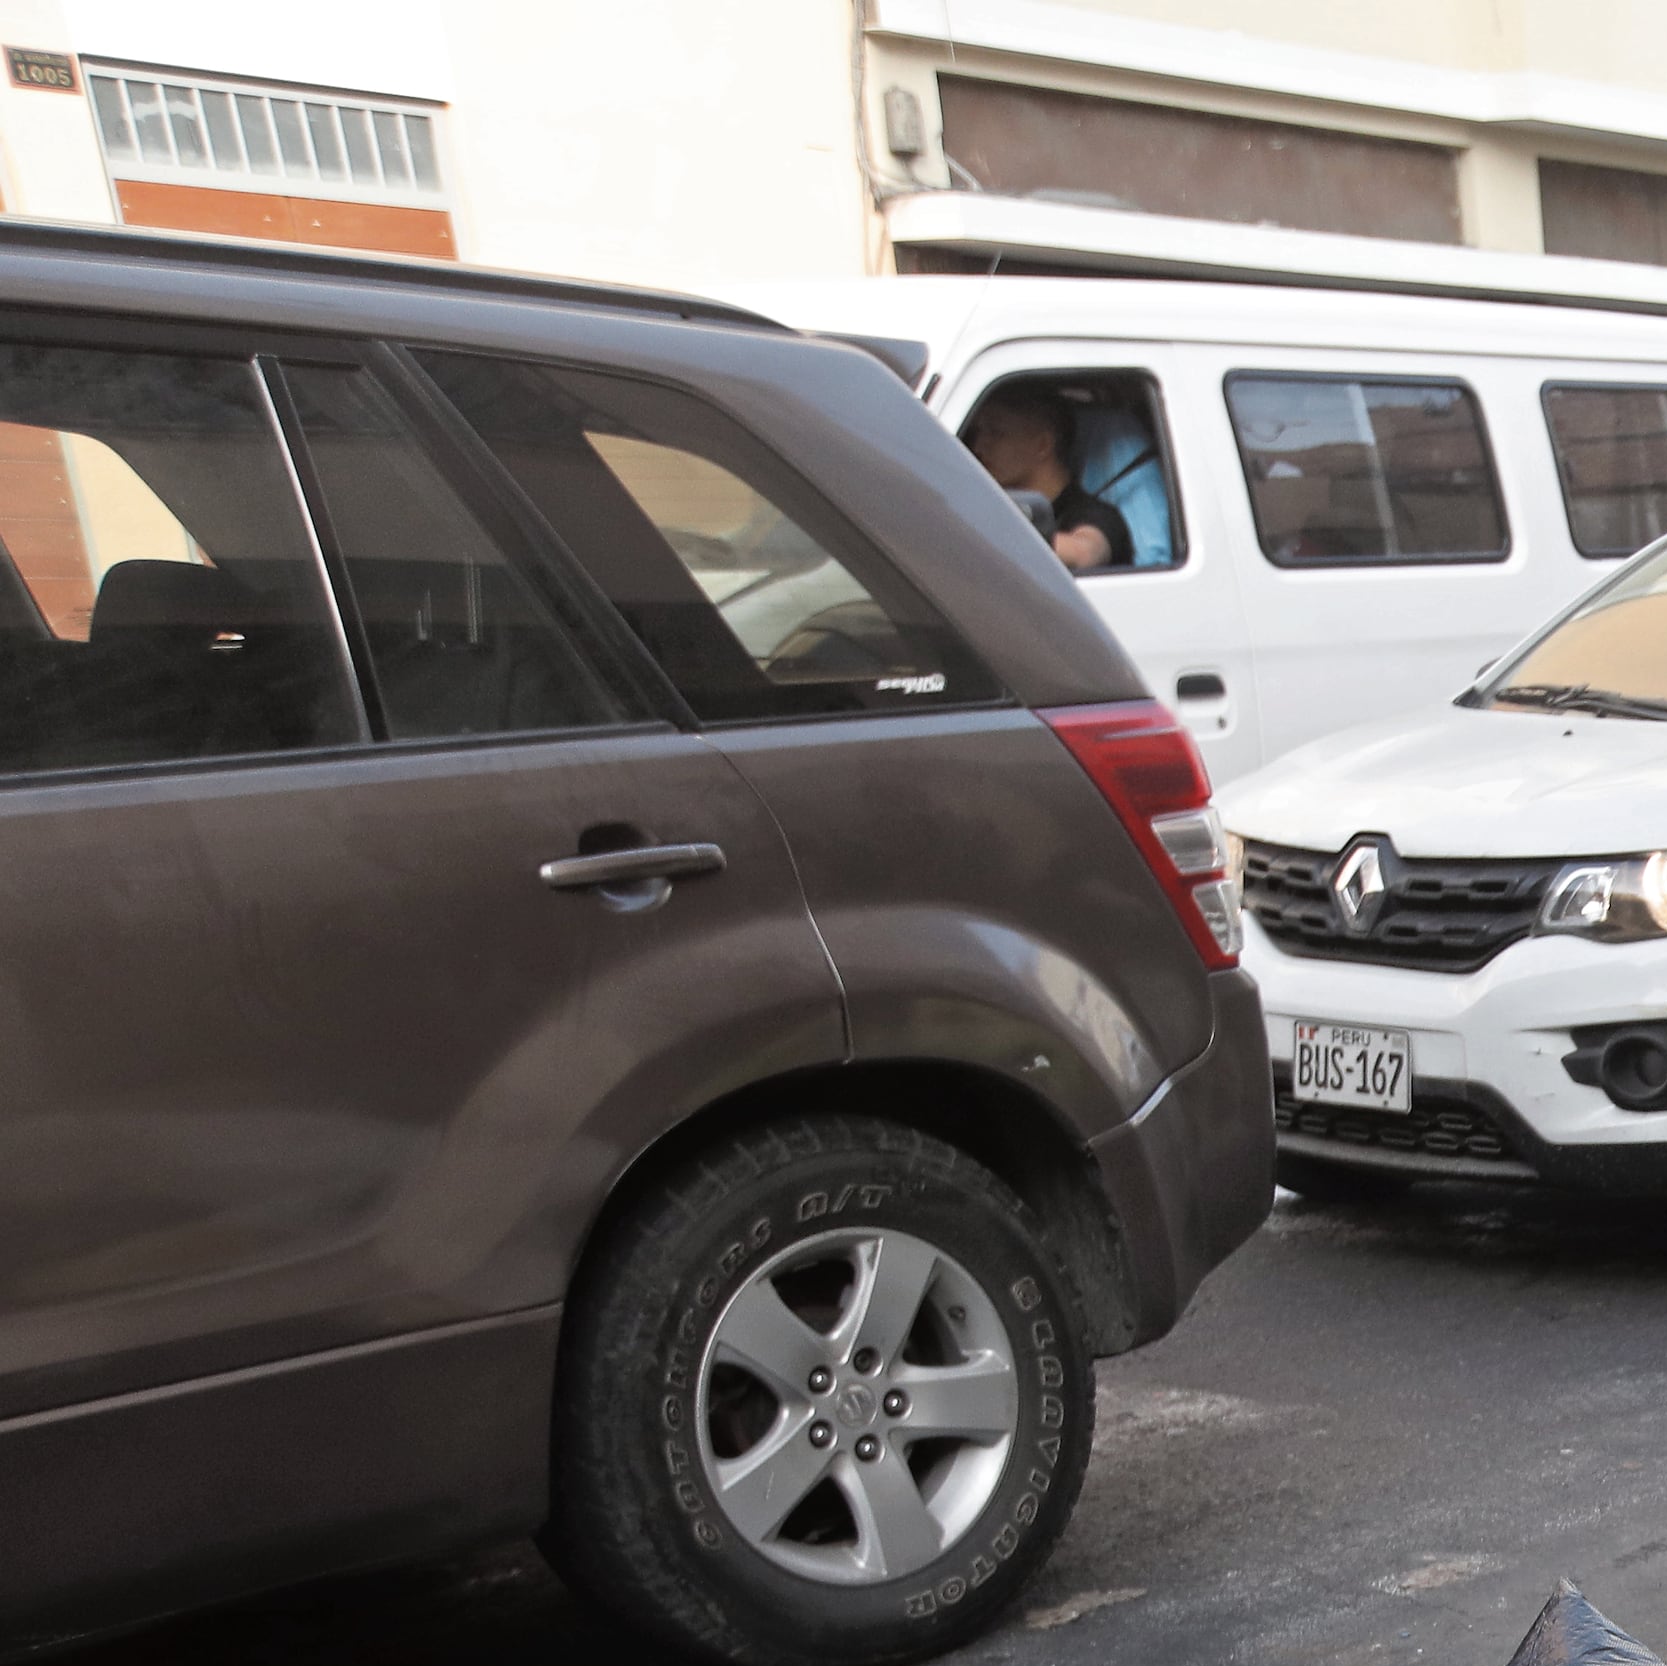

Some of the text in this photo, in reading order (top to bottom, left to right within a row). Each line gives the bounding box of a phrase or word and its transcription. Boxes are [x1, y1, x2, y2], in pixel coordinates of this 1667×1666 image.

[16, 63, 72, 87] 1005
[1332, 1027, 1372, 1047] PERU
[1299, 1043, 1404, 1097] BUS-167
[796, 1183, 892, 1221] A/T
